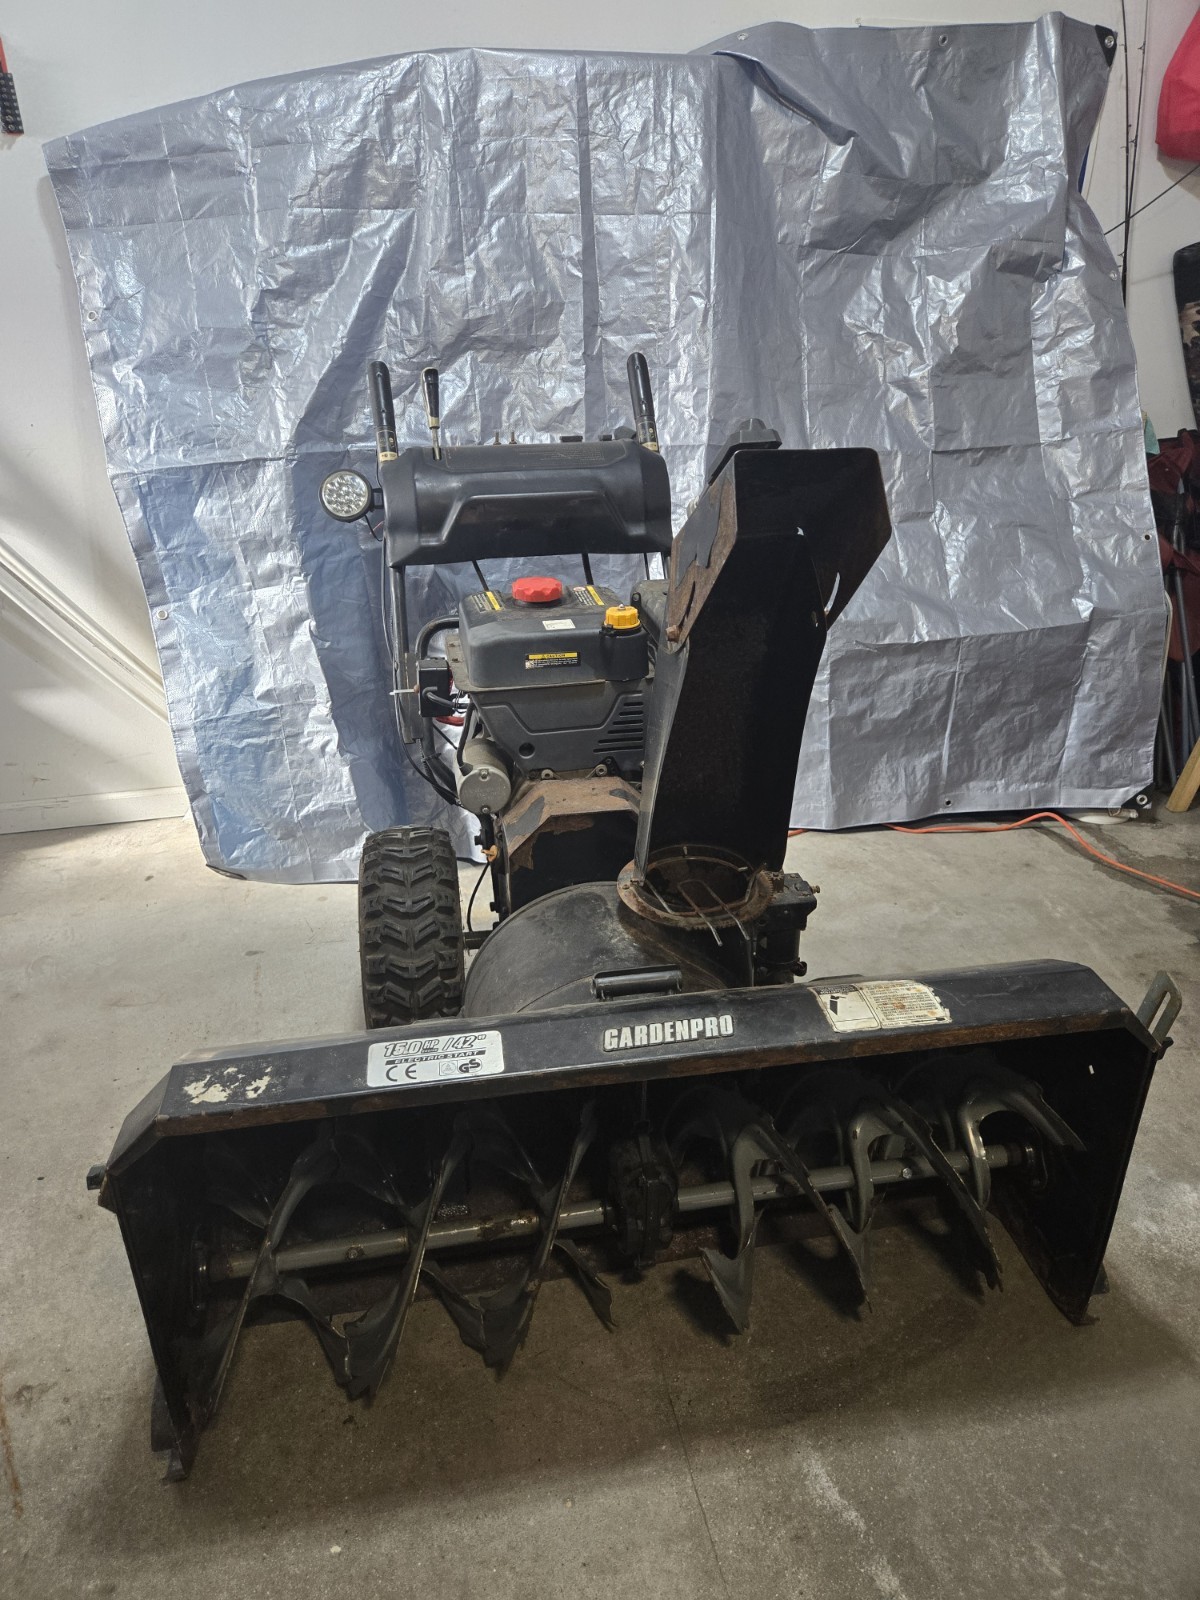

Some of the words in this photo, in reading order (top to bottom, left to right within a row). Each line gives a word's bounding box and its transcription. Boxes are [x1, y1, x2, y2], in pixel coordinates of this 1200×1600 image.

[603, 1014, 734, 1052] GARDENPRO
[422, 1039, 440, 1050] HP
[394, 1055, 444, 1064] ELECTRIC
[445, 1051, 479, 1060] START
[385, 1063, 417, 1082] CE
[458, 1058, 481, 1073] GS
